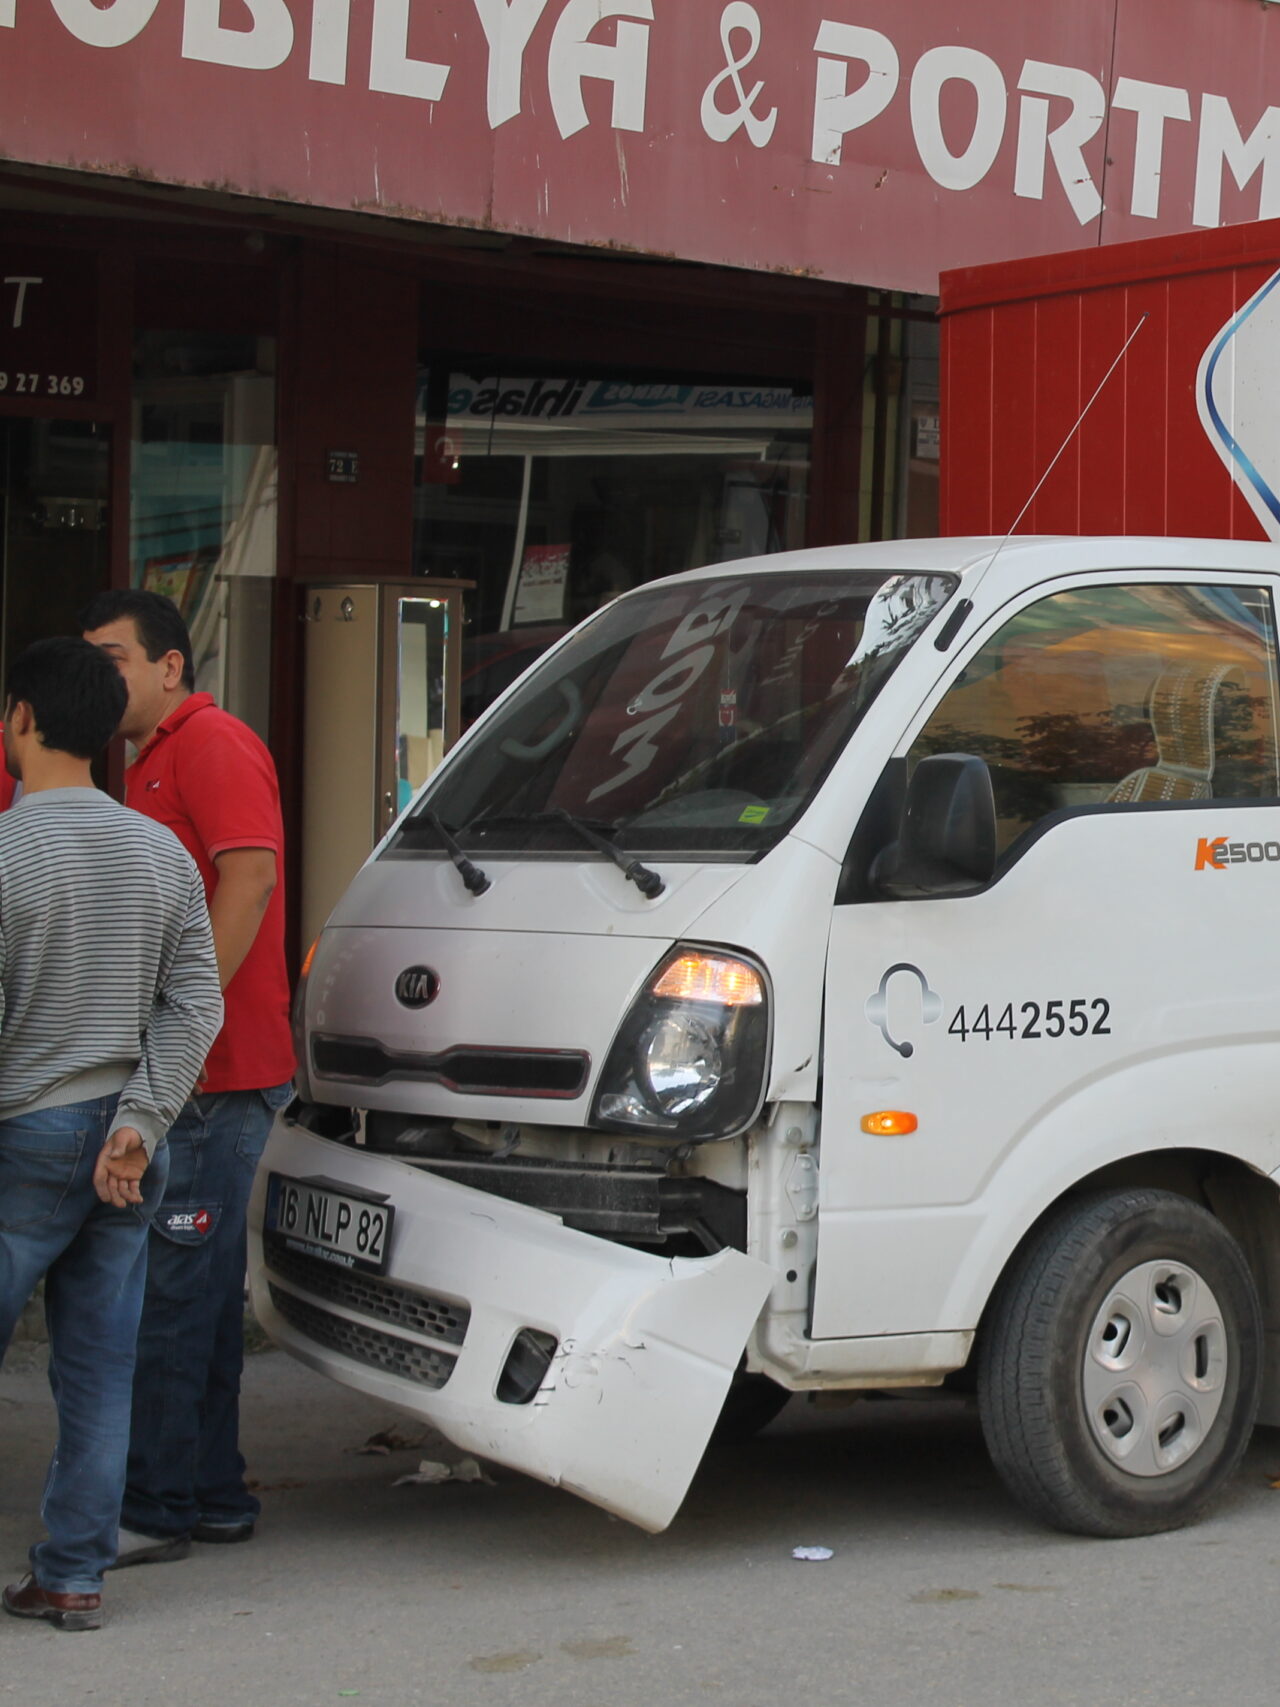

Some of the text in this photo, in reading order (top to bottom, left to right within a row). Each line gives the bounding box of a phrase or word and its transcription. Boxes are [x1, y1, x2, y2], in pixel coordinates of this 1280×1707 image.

[0, 0, 655, 140] ILYA
[700, 1, 778, 148] &
[16, 373, 39, 393] 27
[48, 374, 85, 396] 369
[400, 973, 429, 999] KIA
[948, 998, 1111, 1042] 4442552
[280, 1185, 299, 1230] 16
[305, 1191, 351, 1244] NLP
[356, 1209, 384, 1257] 82
